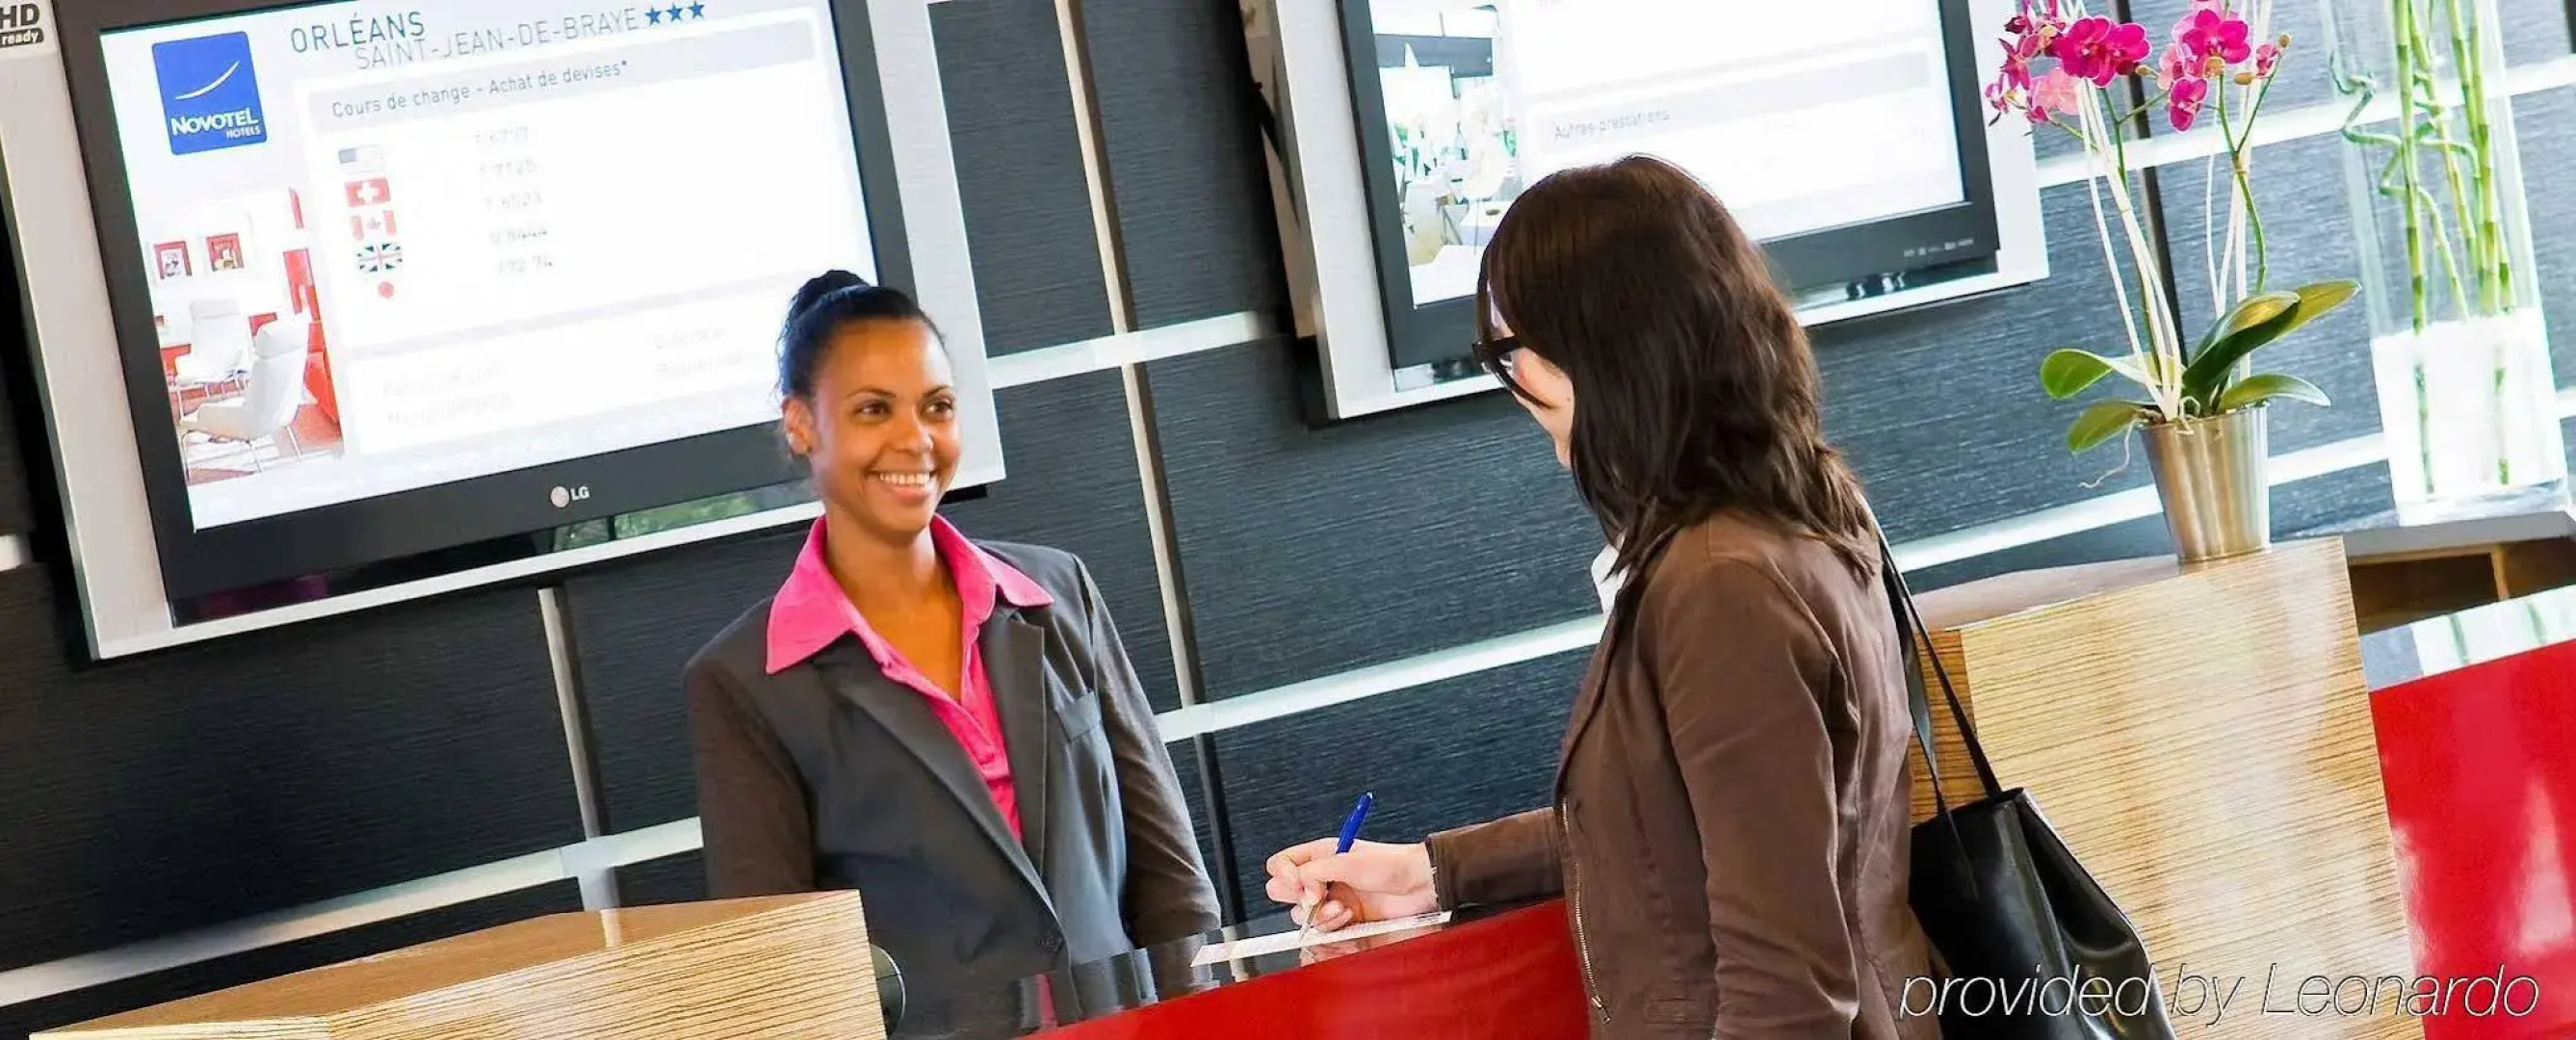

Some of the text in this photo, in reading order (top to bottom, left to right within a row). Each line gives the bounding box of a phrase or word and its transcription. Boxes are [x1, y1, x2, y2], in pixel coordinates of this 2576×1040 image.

[0, 4, 40, 29] HD
[2, 30, 39, 45] ready
[291, 11, 425, 53] ORLÉANS
[355, 8, 639, 71] SAINT-JEAN-DE-BRAYE
[332, 97, 382, 118] Cours
[387, 91, 406, 111] de
[413, 84, 471, 108] change
[488, 73, 533, 94] Achat
[538, 68, 559, 88] de
[171, 107, 259, 137] NOVOTEL
[225, 126, 261, 140] HOTELS
[570, 486, 590, 501] LG
